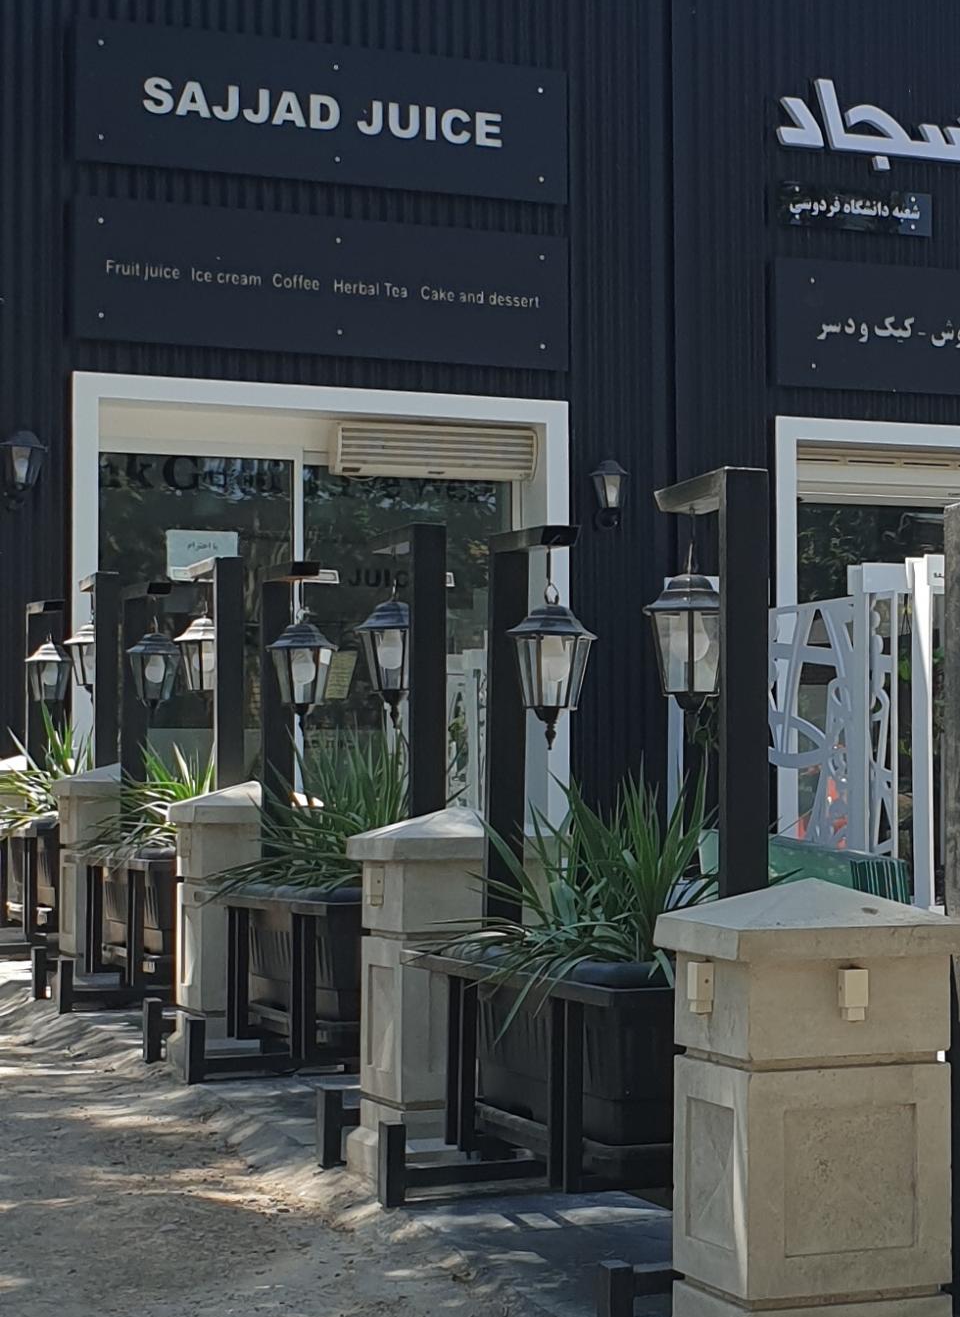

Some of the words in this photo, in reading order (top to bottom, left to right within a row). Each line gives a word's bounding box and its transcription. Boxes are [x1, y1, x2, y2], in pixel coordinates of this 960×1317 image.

[141, 75, 341, 131] SAJJAD
[355, 99, 503, 149] JUICE
[843, 198, 890, 218] دانشگاه
[891, 204, 921, 222] شعبه
[105, 259, 141, 277] Fruit
[143, 263, 180, 281] juice
[190, 267, 213, 283] Ice
[216, 272, 262, 286] cream
[272, 273, 320, 291] Coffee
[333, 279, 380, 297] Herbal
[384, 282, 409, 299] Tea
[420, 286, 455, 302] Cake
[459, 291, 485, 305] and
[488, 291, 540, 309] dessert
[873, 315, 916, 344] کیک
[347, 568, 409, 588] JUIC
